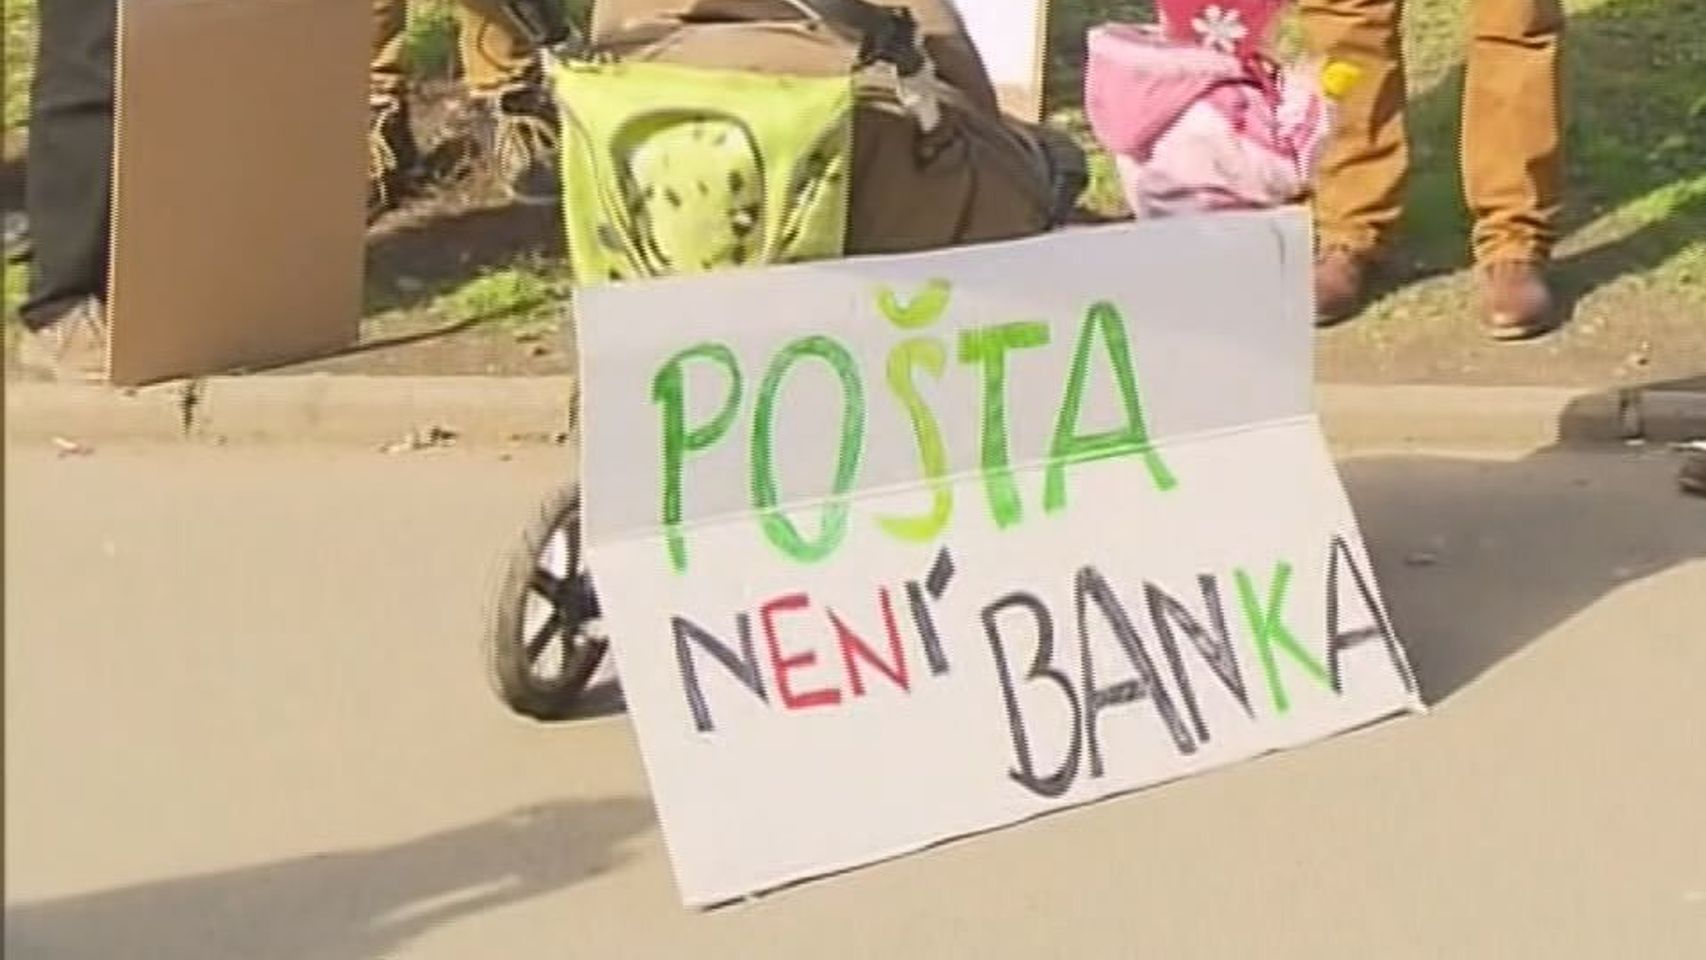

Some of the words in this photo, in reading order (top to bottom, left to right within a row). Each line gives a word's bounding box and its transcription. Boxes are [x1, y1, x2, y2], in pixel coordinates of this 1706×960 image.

[651, 278, 1178, 574] POŠTA
[672, 547, 956, 734] NENÍ
[980, 536, 1421, 797] BANKA
